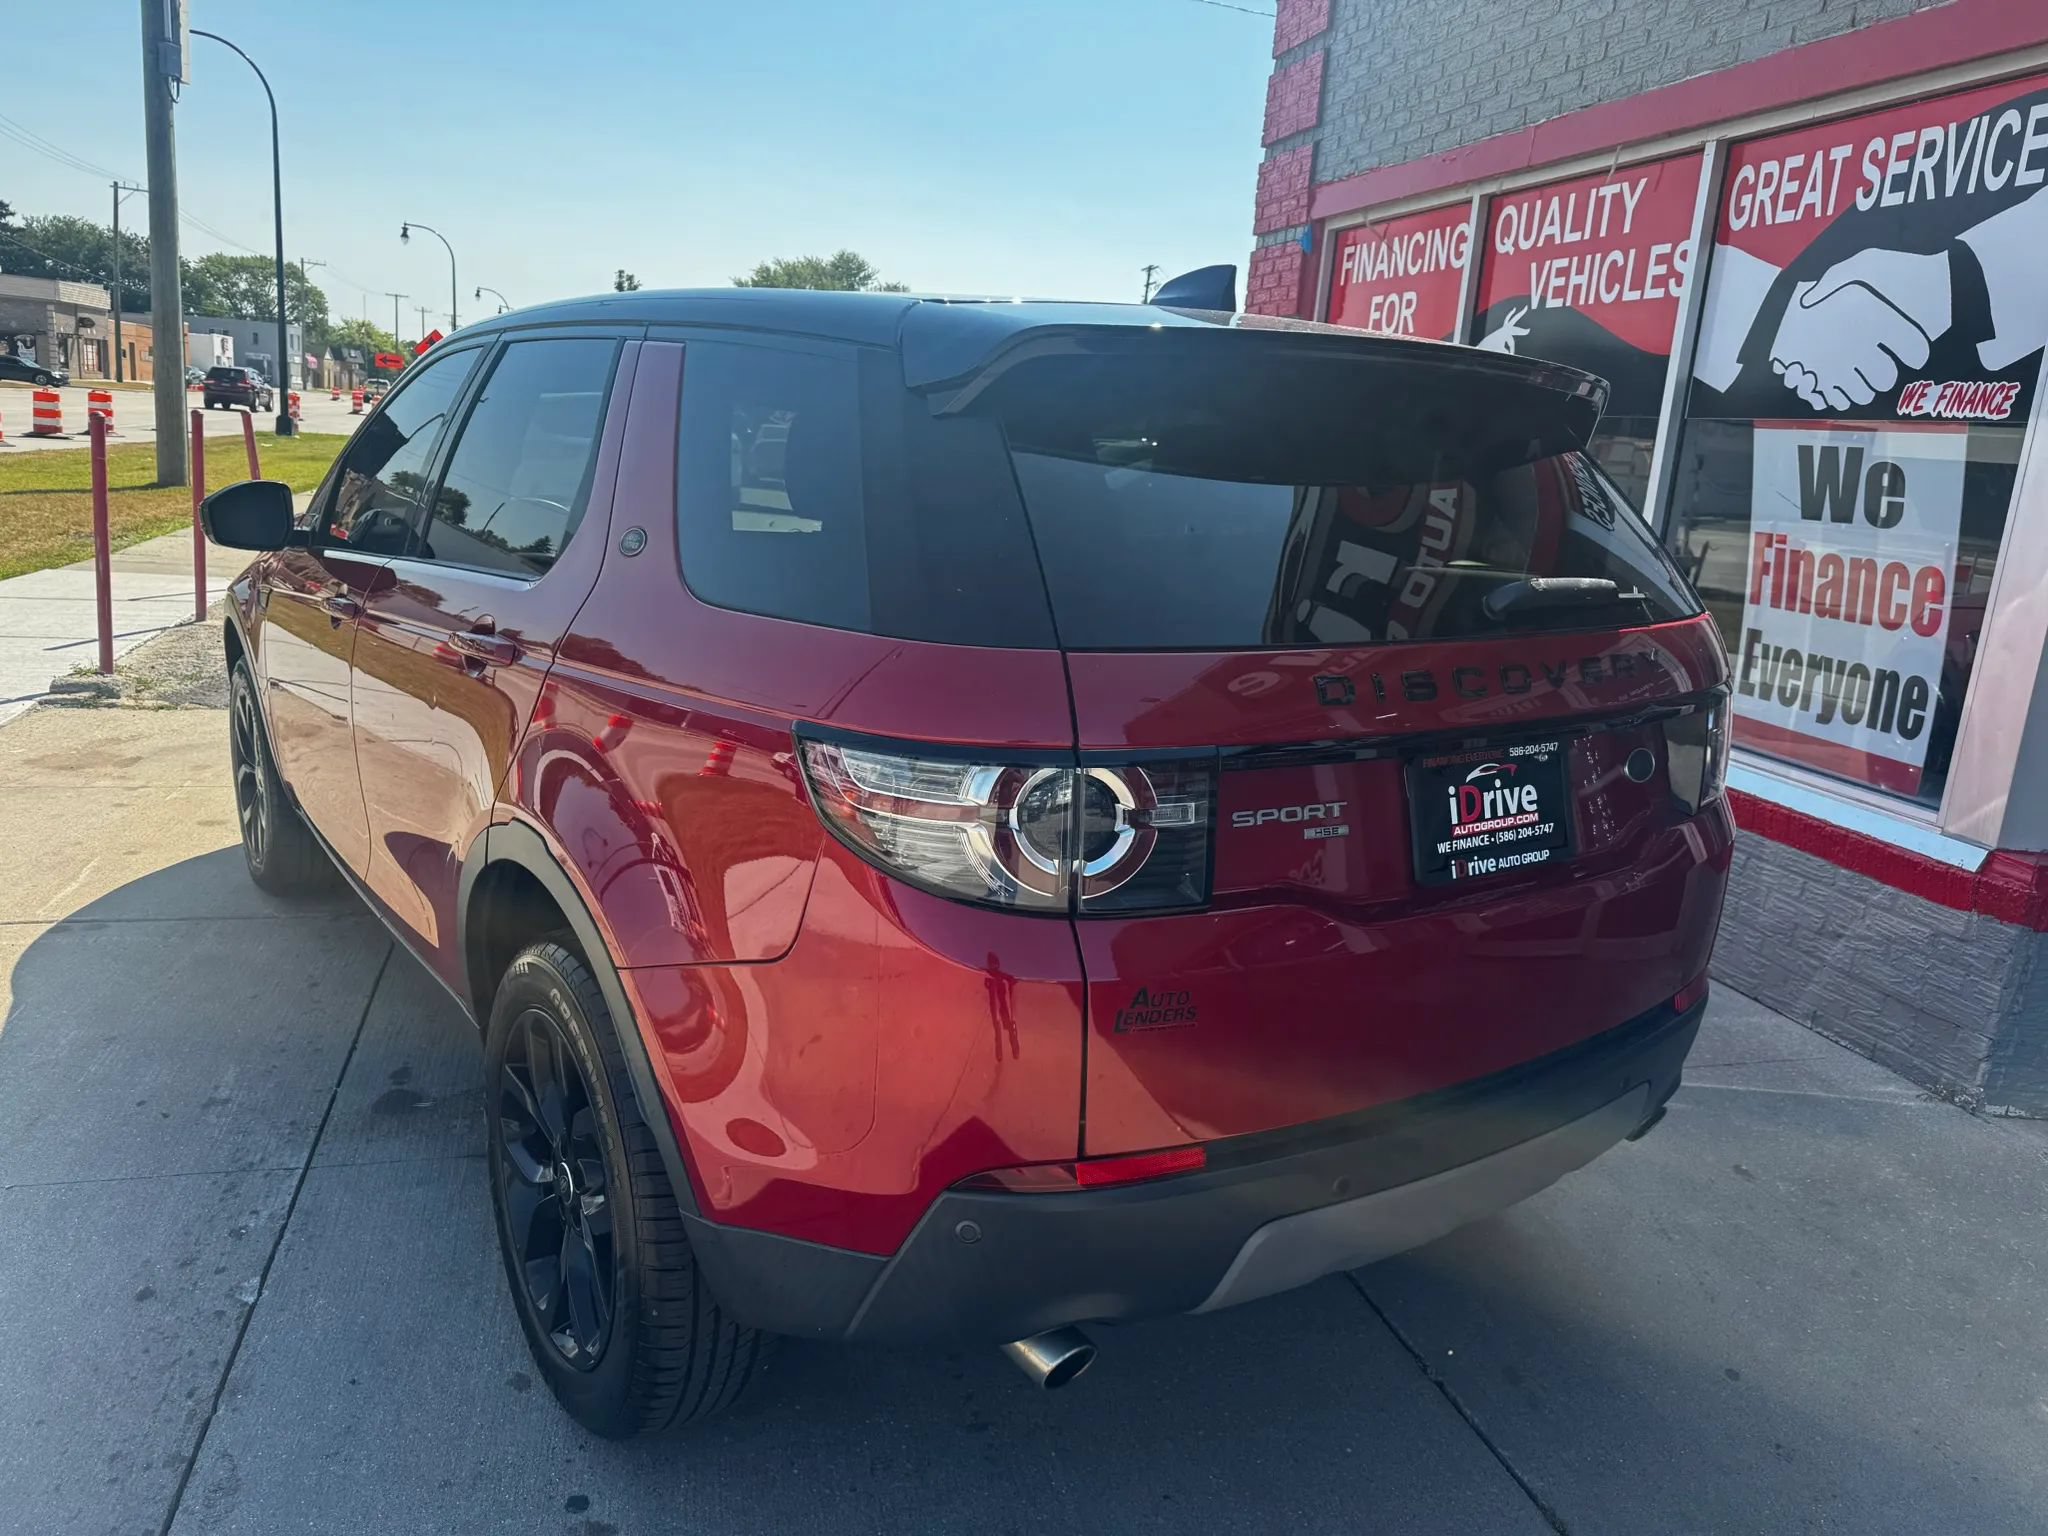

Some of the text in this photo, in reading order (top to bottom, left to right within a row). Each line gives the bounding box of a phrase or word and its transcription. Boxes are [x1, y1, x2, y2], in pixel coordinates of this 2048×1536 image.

[1728, 102, 2048, 231] GREAT SERVICE
[1494, 177, 1647, 257] QUALITY
[1340, 222, 1470, 286] FINANCING
[1530, 239, 1691, 310] VEHICLES
[1368, 291, 1418, 335] FOR
[1899, 381, 2019, 419] WE FINANCE
[1797, 444, 1906, 529] We
[1749, 532, 1946, 638] Finance
[1738, 628, 1929, 740] Everyone
[1509, 742, 1559, 757] 586-204-5747
[1232, 802, 1348, 827] SPORT
[1448, 778, 1538, 825] iDrive
[1453, 813, 1539, 836] AUTOGROUP.COM
[1437, 823, 1554, 854] WE FINANCE (586) 204-5747
[1450, 849, 1550, 880] iDrive AUTO GROUP
